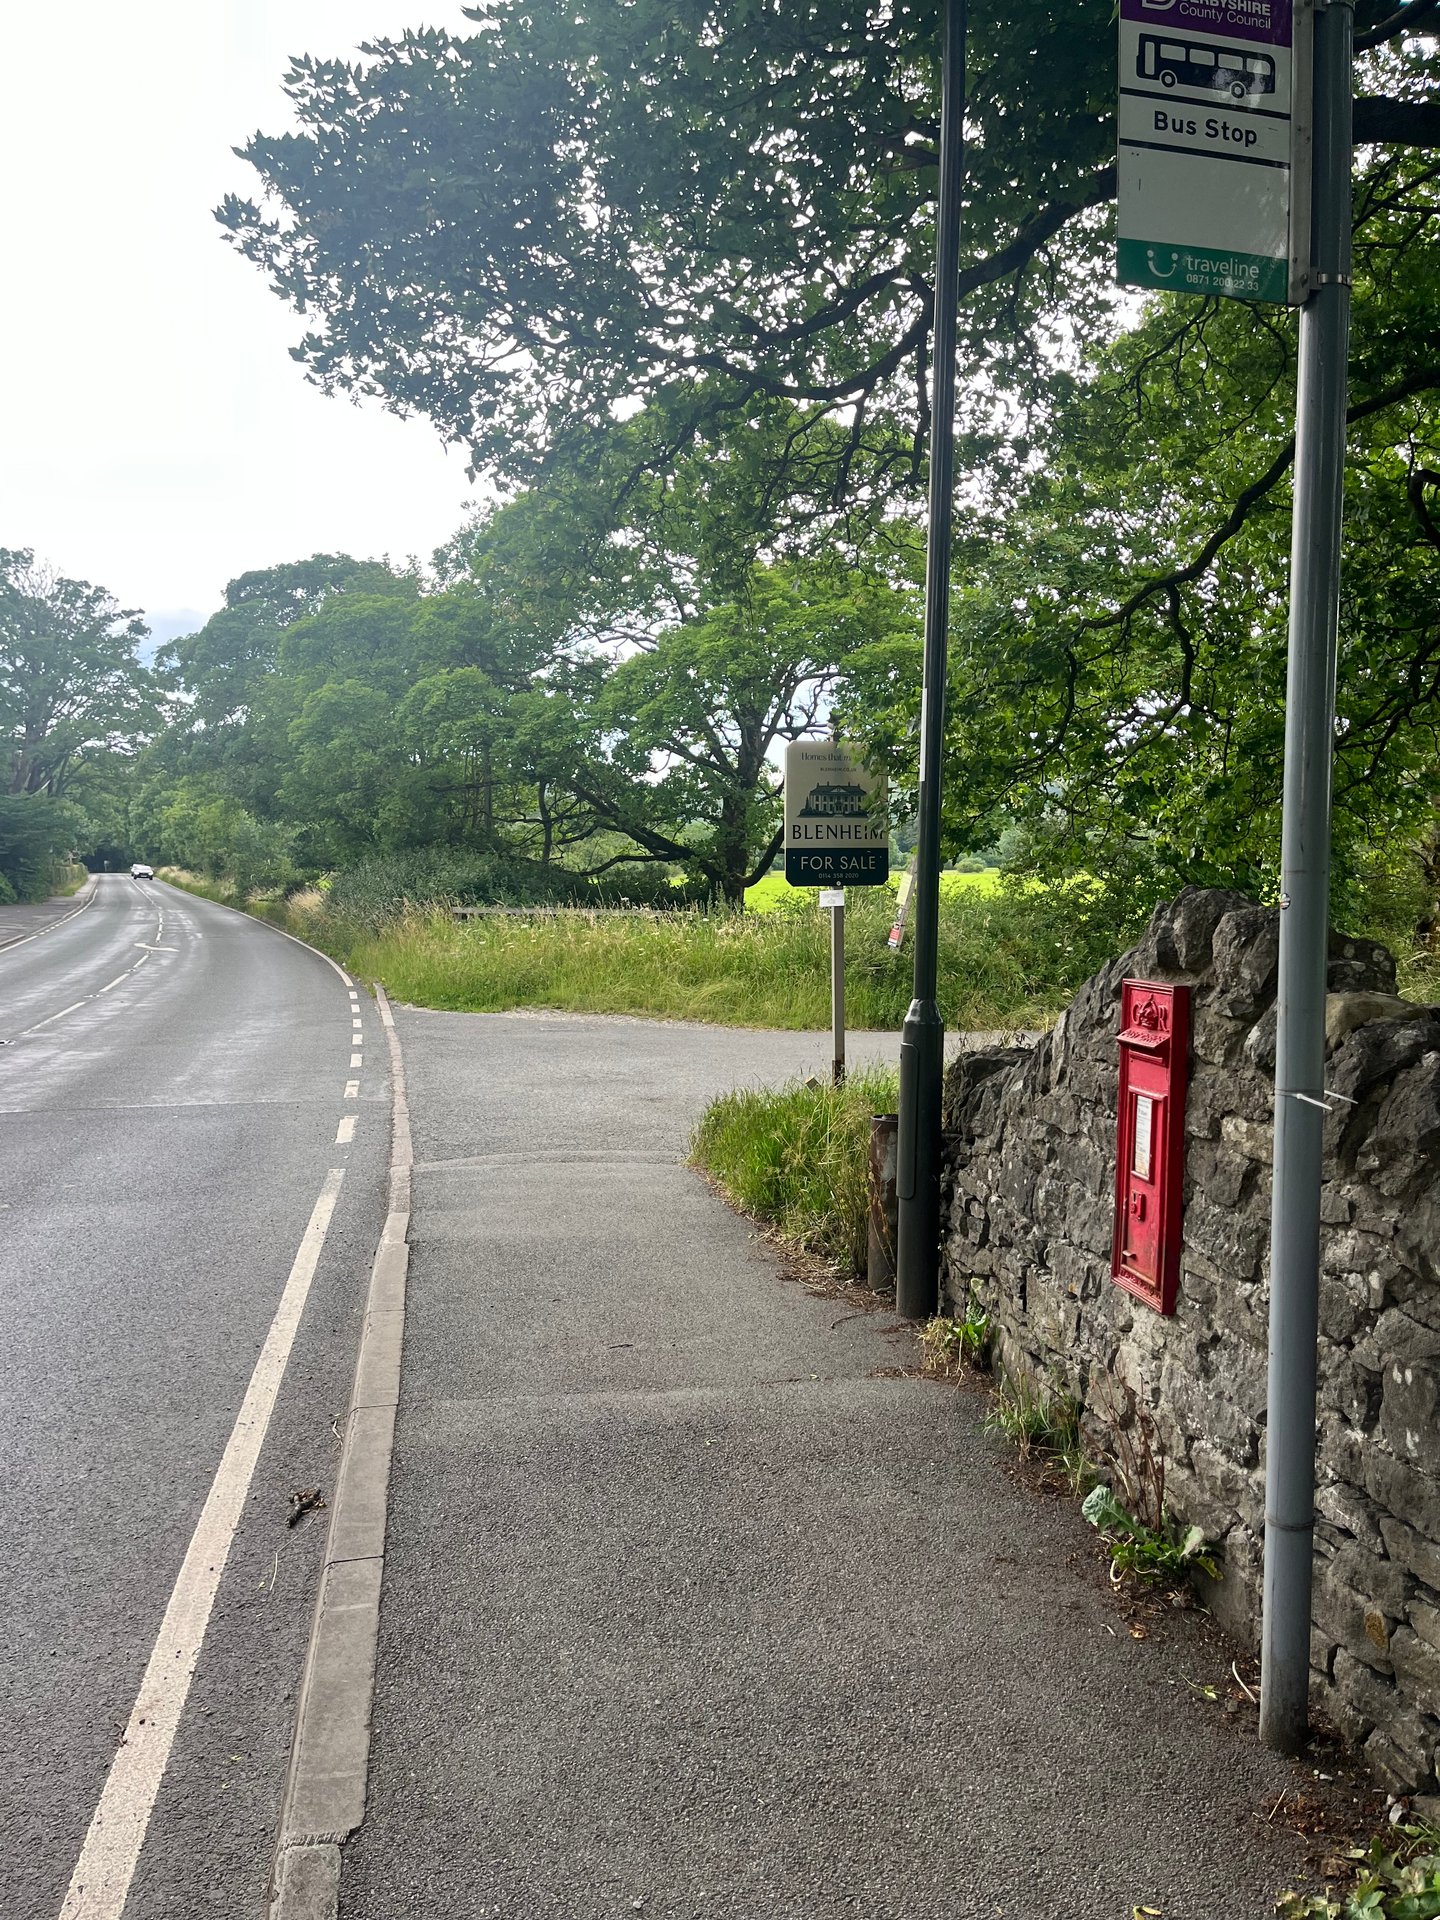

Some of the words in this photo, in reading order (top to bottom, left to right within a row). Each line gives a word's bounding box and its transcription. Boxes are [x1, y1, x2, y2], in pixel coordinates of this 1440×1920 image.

[1179, 2, 1223, 23] County
[1226, 10, 1271, 29] Council
[1183, 0, 1271, 16] BYSHIRE
[1154, 110, 1197, 135] Bus
[1204, 118, 1257, 147] Stop
[1186, 255, 1260, 279] traveline
[1186, 274, 1209, 285] 0871
[1234, 280, 1245, 289] 22
[1247, 281, 1259, 291] 33
[801, 752, 827, 761] Homes
[801, 856, 834, 870] FOR
[840, 856, 876, 870] SALE
